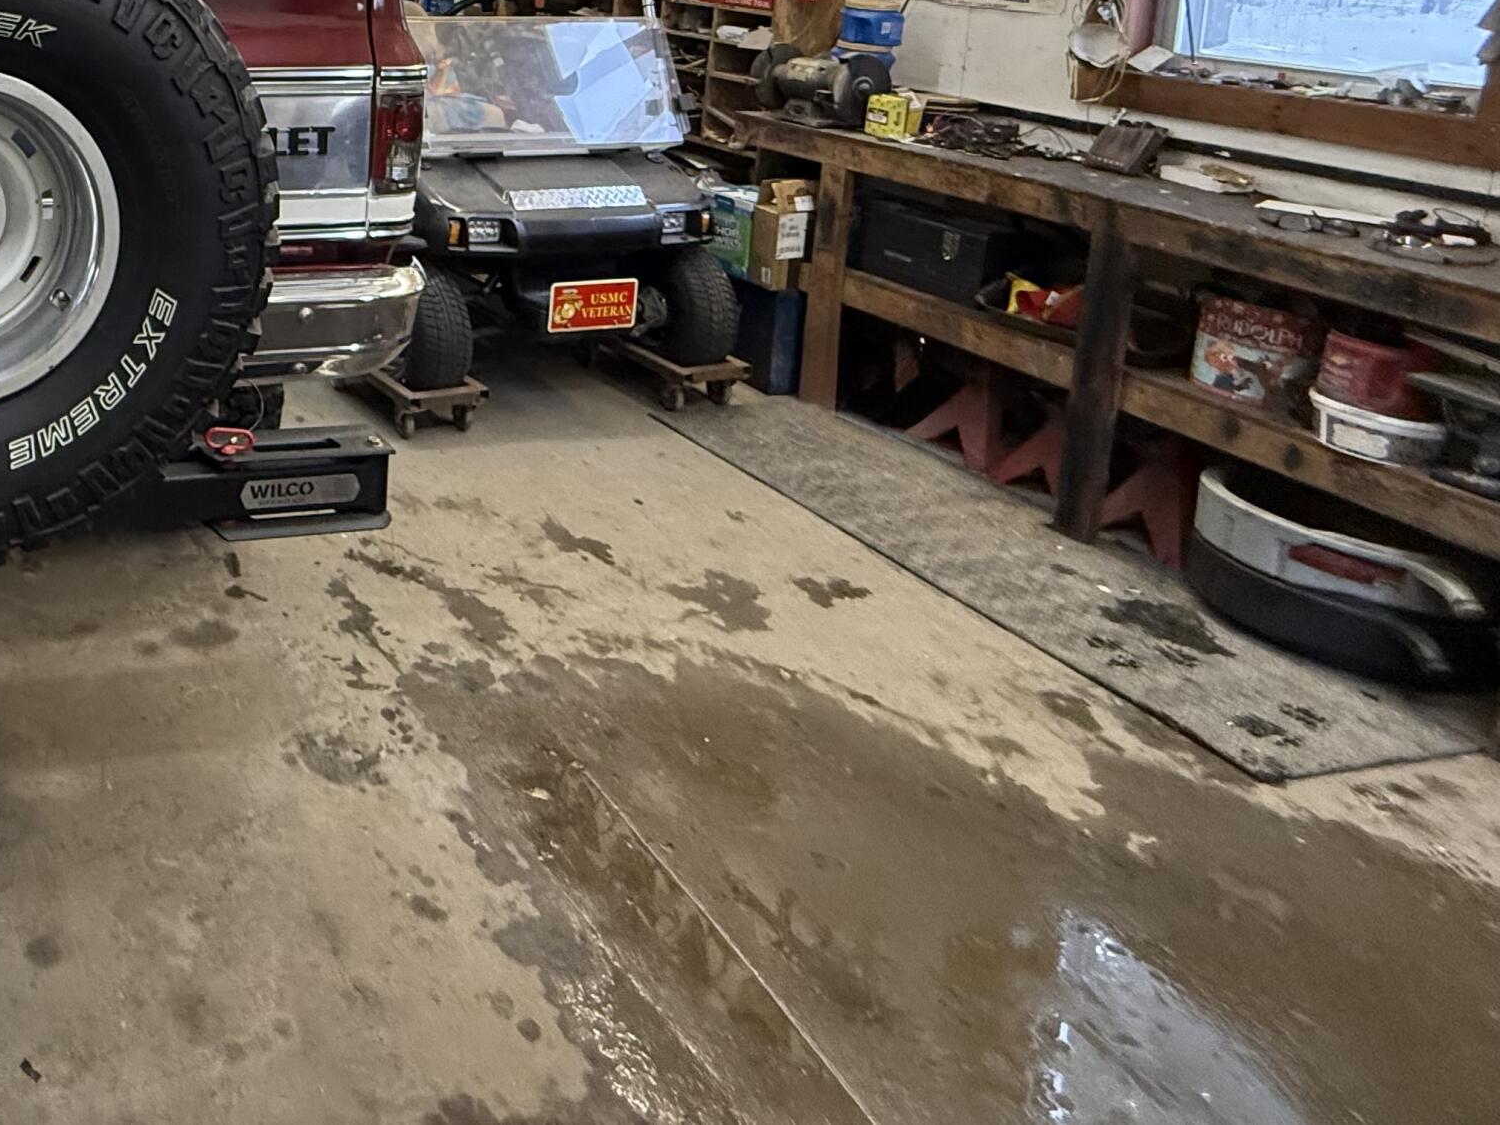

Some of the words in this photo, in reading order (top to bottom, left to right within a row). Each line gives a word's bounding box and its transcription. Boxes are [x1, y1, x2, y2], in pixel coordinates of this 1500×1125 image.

[590, 291, 629, 305] USMC
[581, 305, 633, 319] VETERAN
[1216, 314, 1302, 347] RUDOLPH
[8, 287, 179, 471] EXTREME
[250, 481, 314, 500] WILCO
